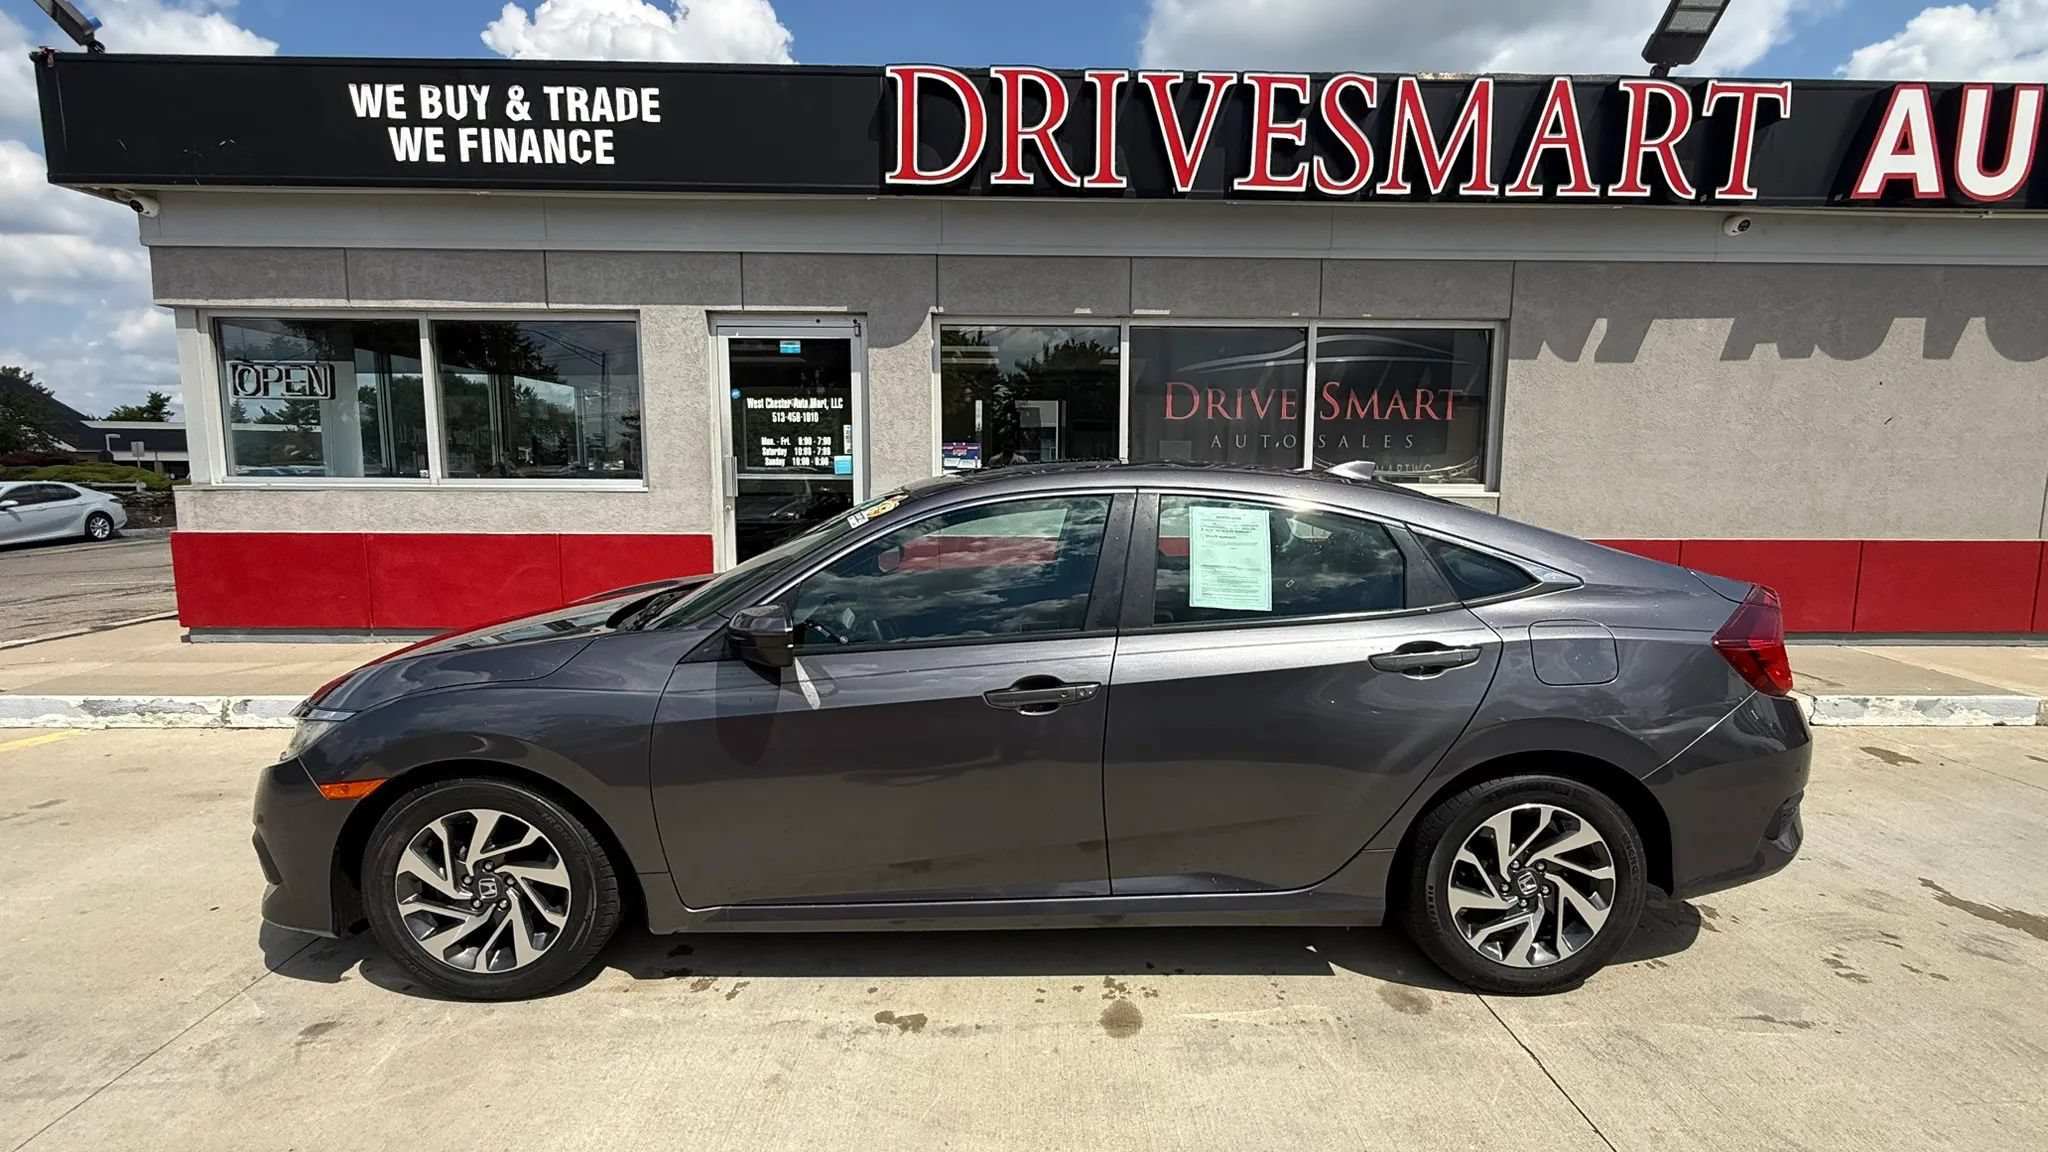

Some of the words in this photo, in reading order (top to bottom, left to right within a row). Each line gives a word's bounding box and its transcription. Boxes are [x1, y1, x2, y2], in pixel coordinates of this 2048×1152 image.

[348, 83, 407, 119] WE
[419, 84, 491, 121] BUY
[505, 84, 533, 122] &
[543, 86, 661, 123] TRADE
[885, 63, 1792, 200] DRIVESMART
[1851, 82, 2046, 202] AU
[387, 126, 446, 163] WE
[458, 127, 615, 165] FINANCE
[234, 364, 326, 397] OPEN
[746, 397, 764, 409] West
[830, 397, 843, 409] LLC
[1163, 381, 1297, 421] DRIVE
[1319, 381, 1464, 421] SMART
[761, 446, 788, 457] Saturday
[817, 446, 831, 456] 7:00
[817, 436, 832, 446] 7:00
[1211, 433, 1297, 449] AUTO
[1318, 434, 1414, 449] SALES
[764, 456, 786, 467] Sunday
